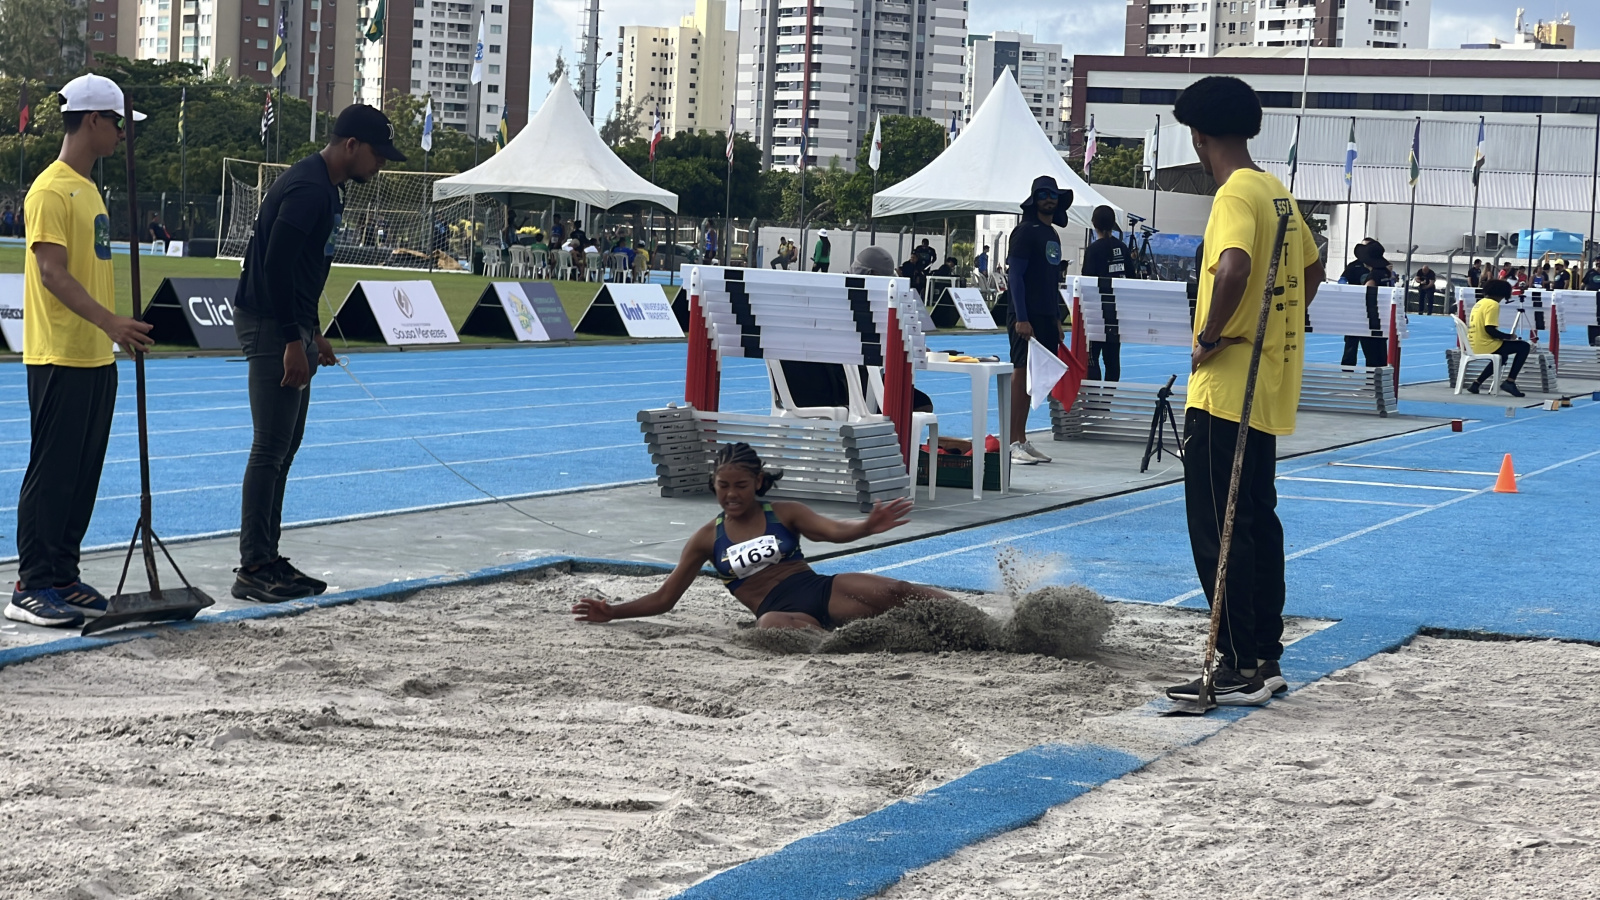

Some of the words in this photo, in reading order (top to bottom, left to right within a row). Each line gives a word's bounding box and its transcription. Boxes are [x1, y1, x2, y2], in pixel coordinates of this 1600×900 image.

[620, 300, 646, 321] Unit
[392, 327, 416, 340] Sousa
[415, 327, 448, 339] Menezes
[734, 545, 776, 569] 163
